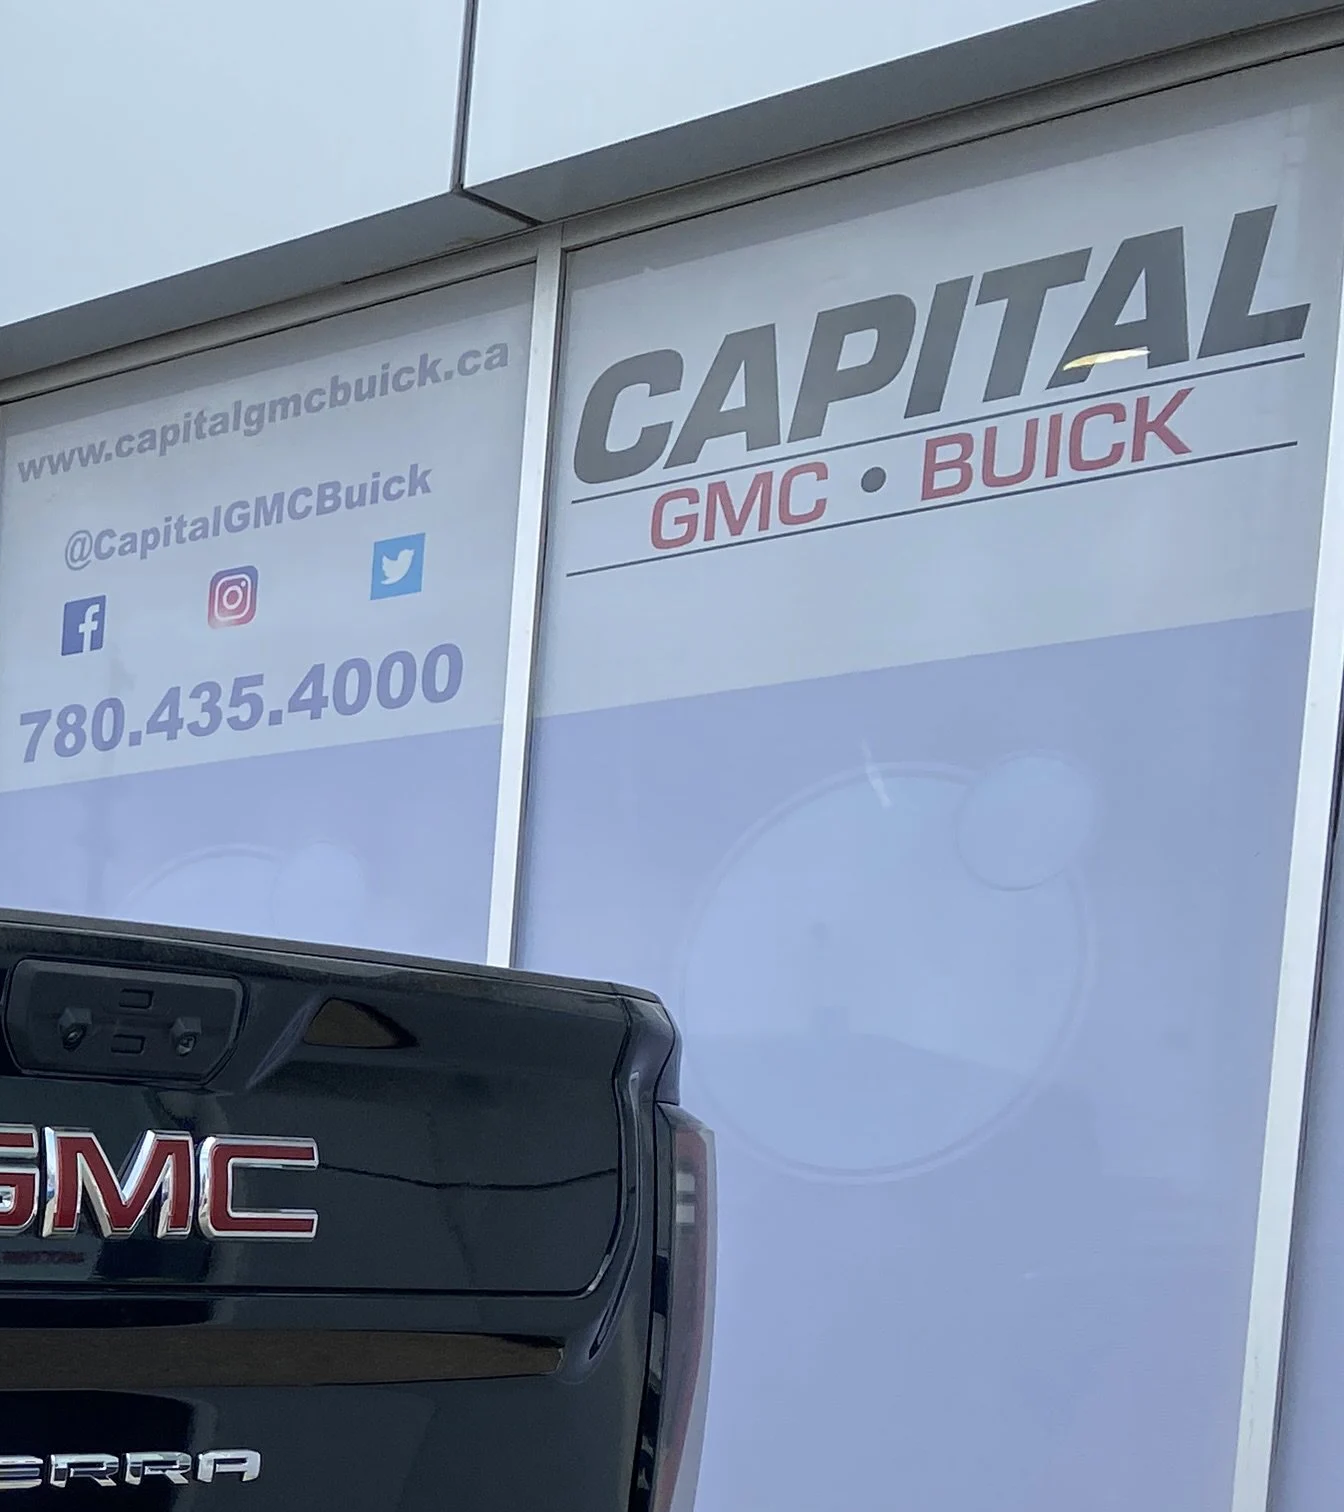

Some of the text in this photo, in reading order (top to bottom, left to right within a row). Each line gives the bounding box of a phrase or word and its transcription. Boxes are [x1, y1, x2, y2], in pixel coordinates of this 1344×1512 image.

[17, 341, 509, 483] www.capitalgmcbuick.ca
[573, 205, 1311, 485] CAPITAL
[64, 463, 432, 572] @CapitalGMCBuick
[650, 387, 1195, 550] GMC BUICK
[19, 643, 463, 763] 780.435.4000
